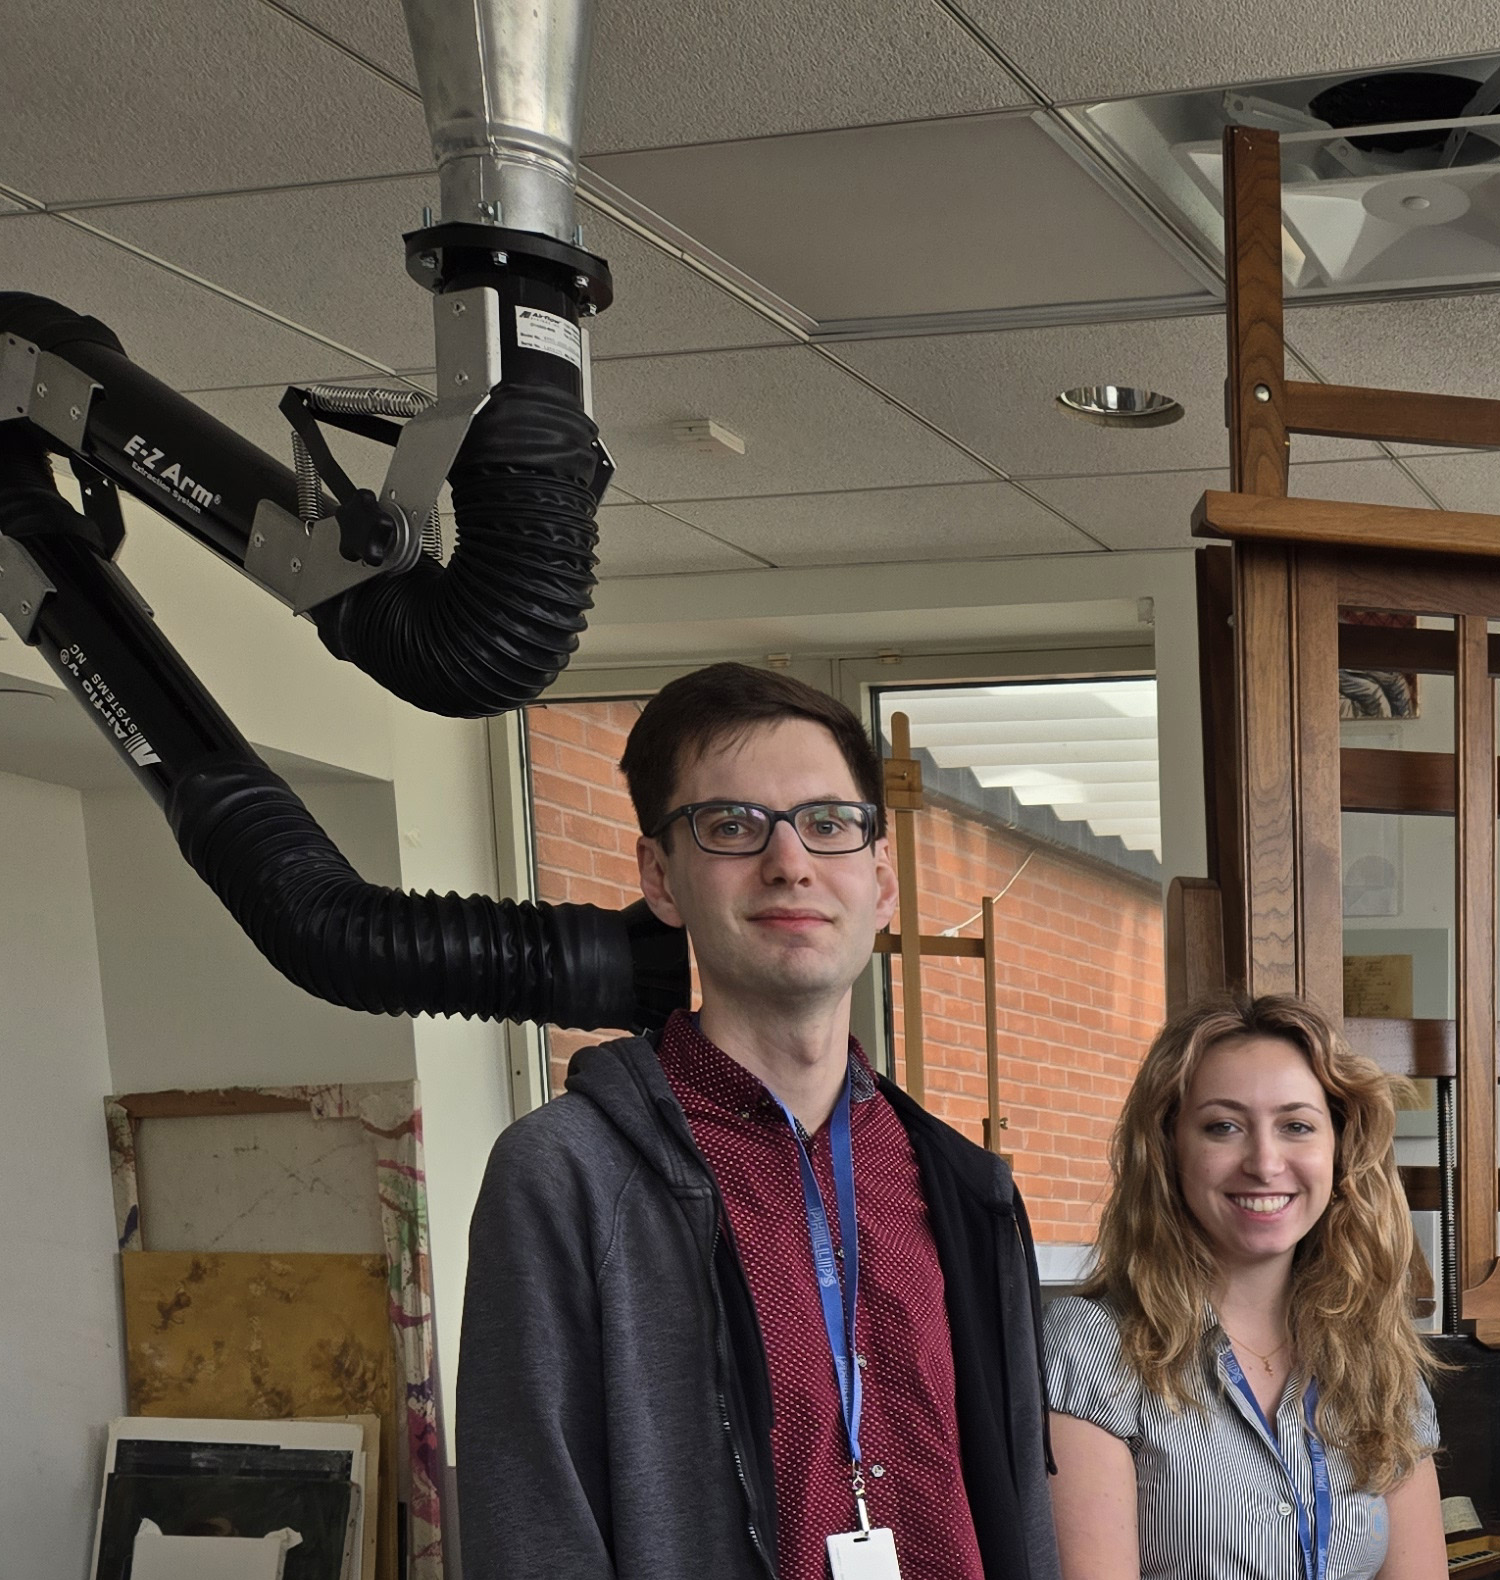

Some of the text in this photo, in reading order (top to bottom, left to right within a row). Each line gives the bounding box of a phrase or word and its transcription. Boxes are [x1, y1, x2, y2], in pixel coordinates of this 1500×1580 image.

[123, 434, 165, 470] E-Z
[132, 461, 201, 513] Extraction System
[69, 644, 138, 735] SYSTEMS NC
[809, 1205, 836, 1288] PHILLIPS
